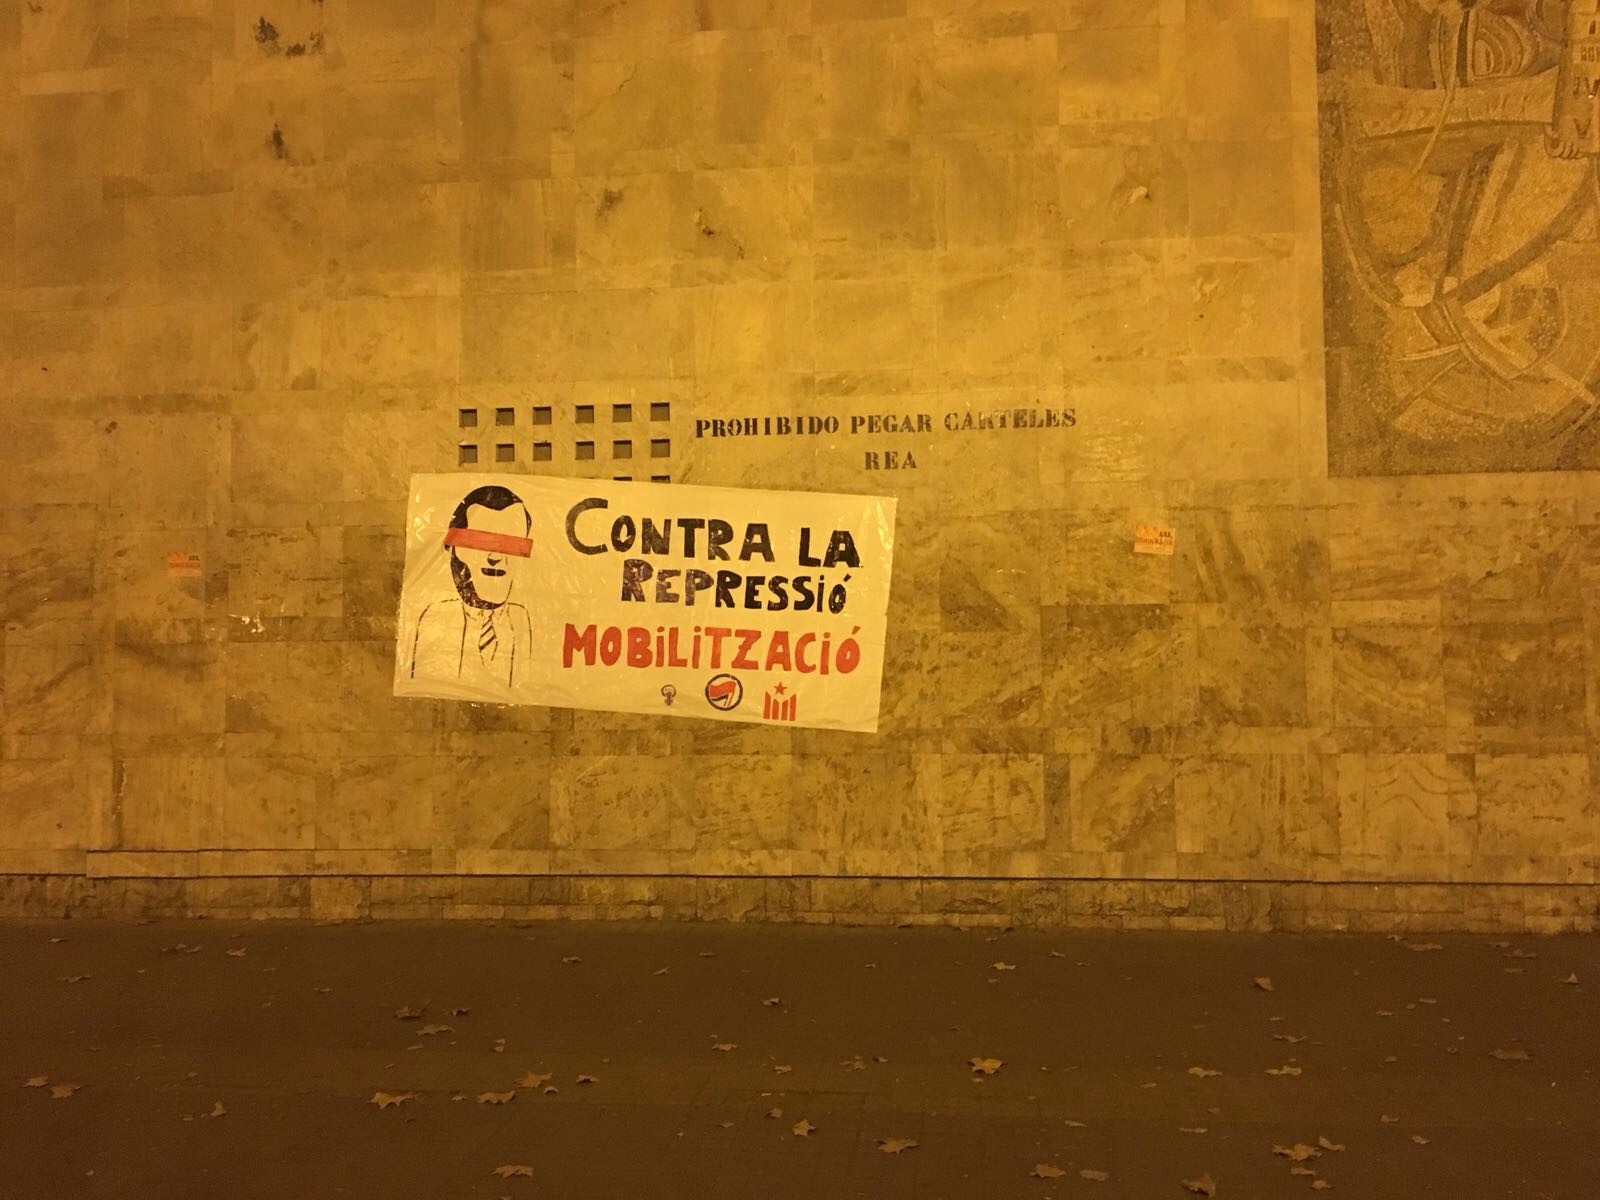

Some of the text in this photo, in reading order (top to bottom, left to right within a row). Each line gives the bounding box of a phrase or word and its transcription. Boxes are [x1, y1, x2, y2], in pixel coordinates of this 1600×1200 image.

[695, 407, 1077, 439] PROHIBIDO PEGAR CARTELES
[864, 450, 918, 471] REA
[565, 497, 862, 569] CONTRA LA
